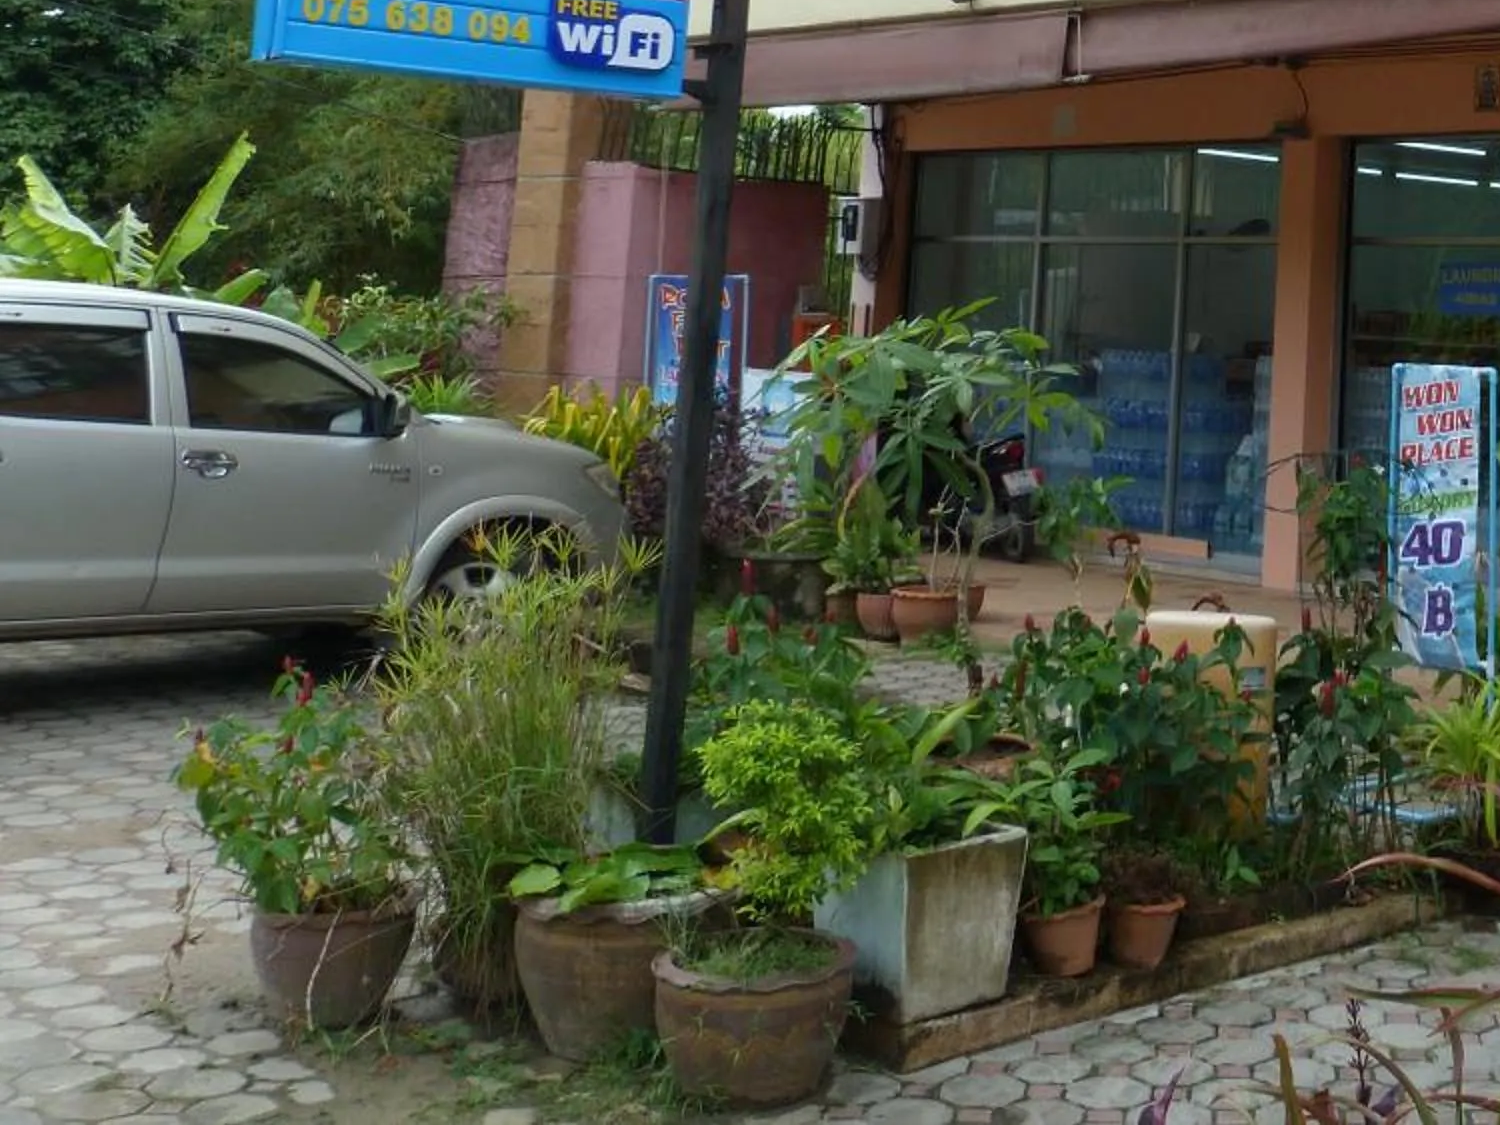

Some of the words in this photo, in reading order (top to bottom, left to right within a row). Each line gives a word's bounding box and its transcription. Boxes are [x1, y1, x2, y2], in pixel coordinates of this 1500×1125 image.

[385, 0, 453, 36] 638
[467, 10, 530, 43] 094
[1403, 380, 1461, 409] WON
[1416, 409, 1473, 436] WON
[1401, 436, 1474, 467] PLACE
[1401, 520, 1466, 568] 40
